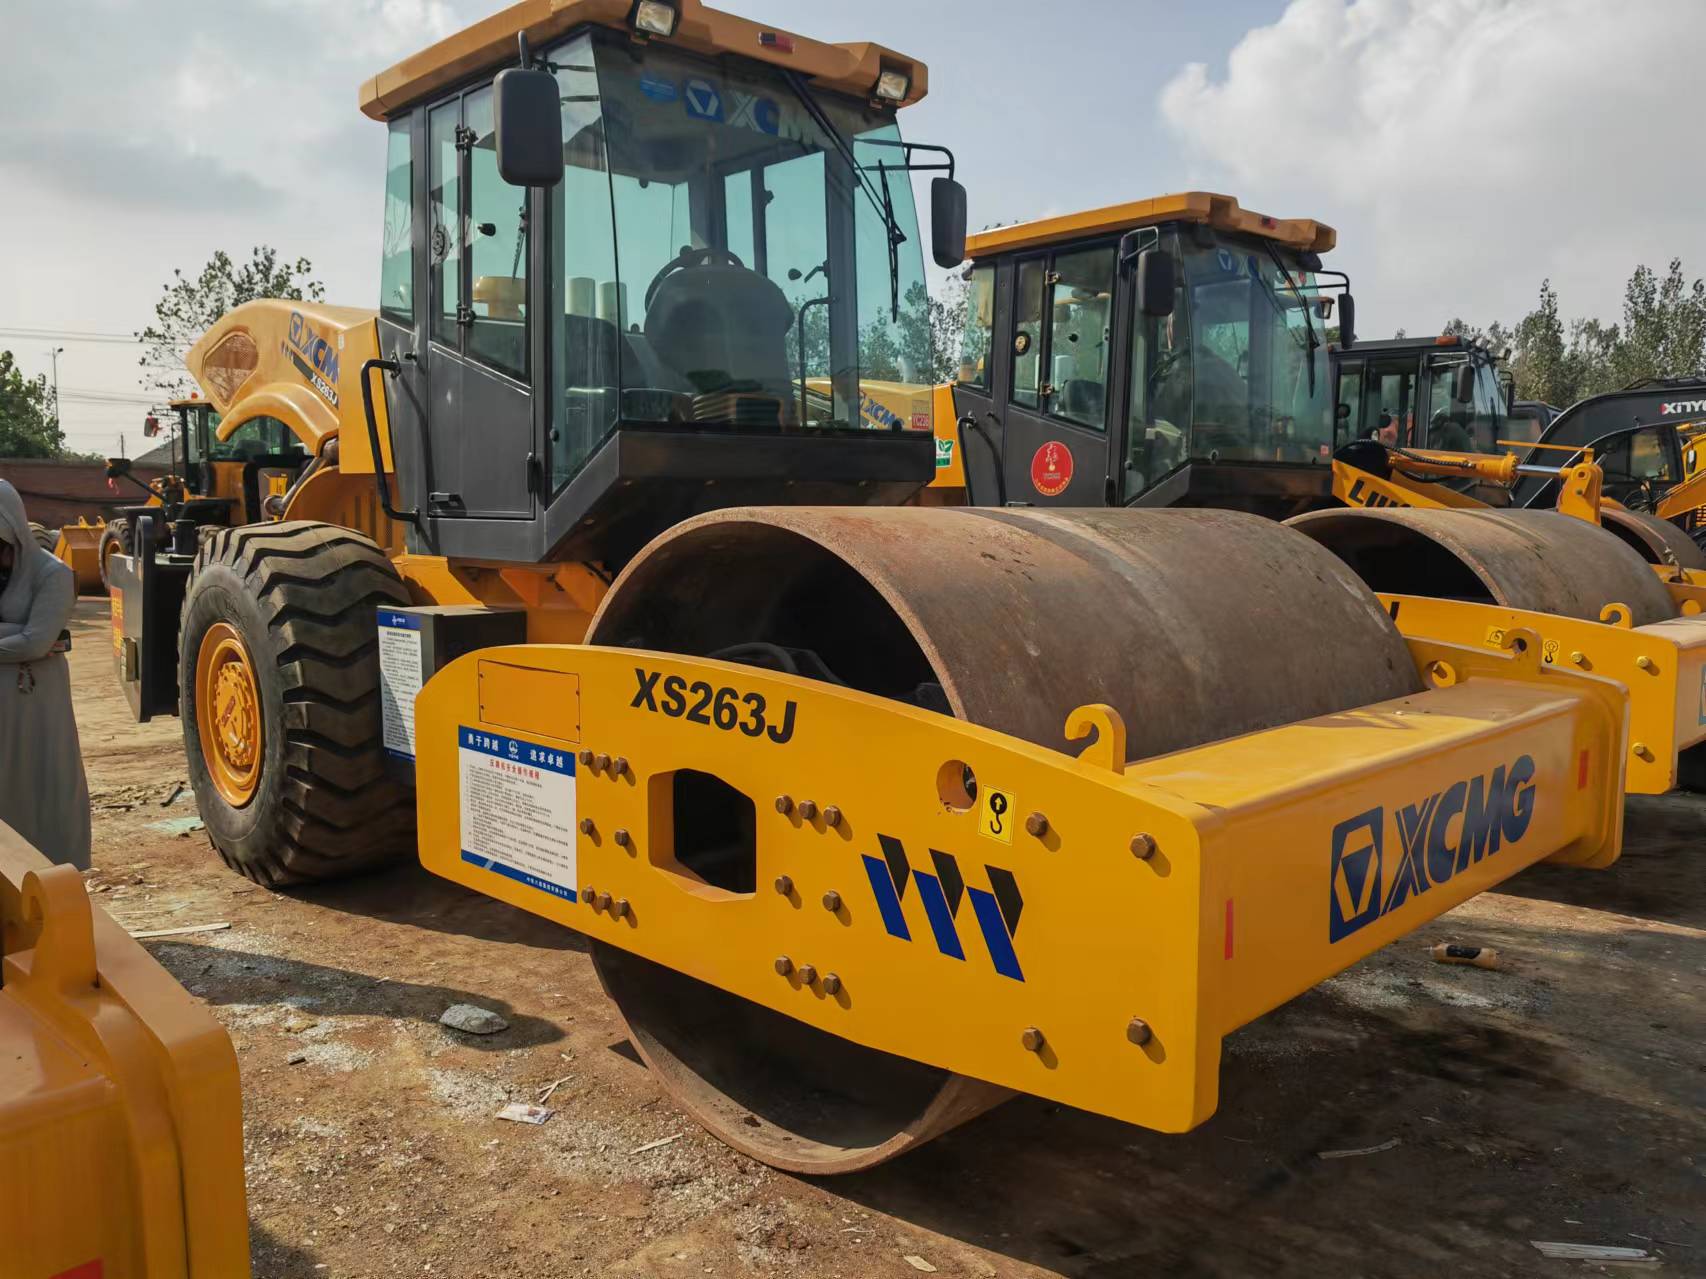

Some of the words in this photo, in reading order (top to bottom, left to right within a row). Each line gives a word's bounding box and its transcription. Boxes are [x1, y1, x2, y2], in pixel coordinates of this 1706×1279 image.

[311, 372, 338, 405] XS263J
[864, 399, 904, 426] XCM
[630, 667, 797, 744] XS263J
[1378, 754, 1536, 919] XCMG
